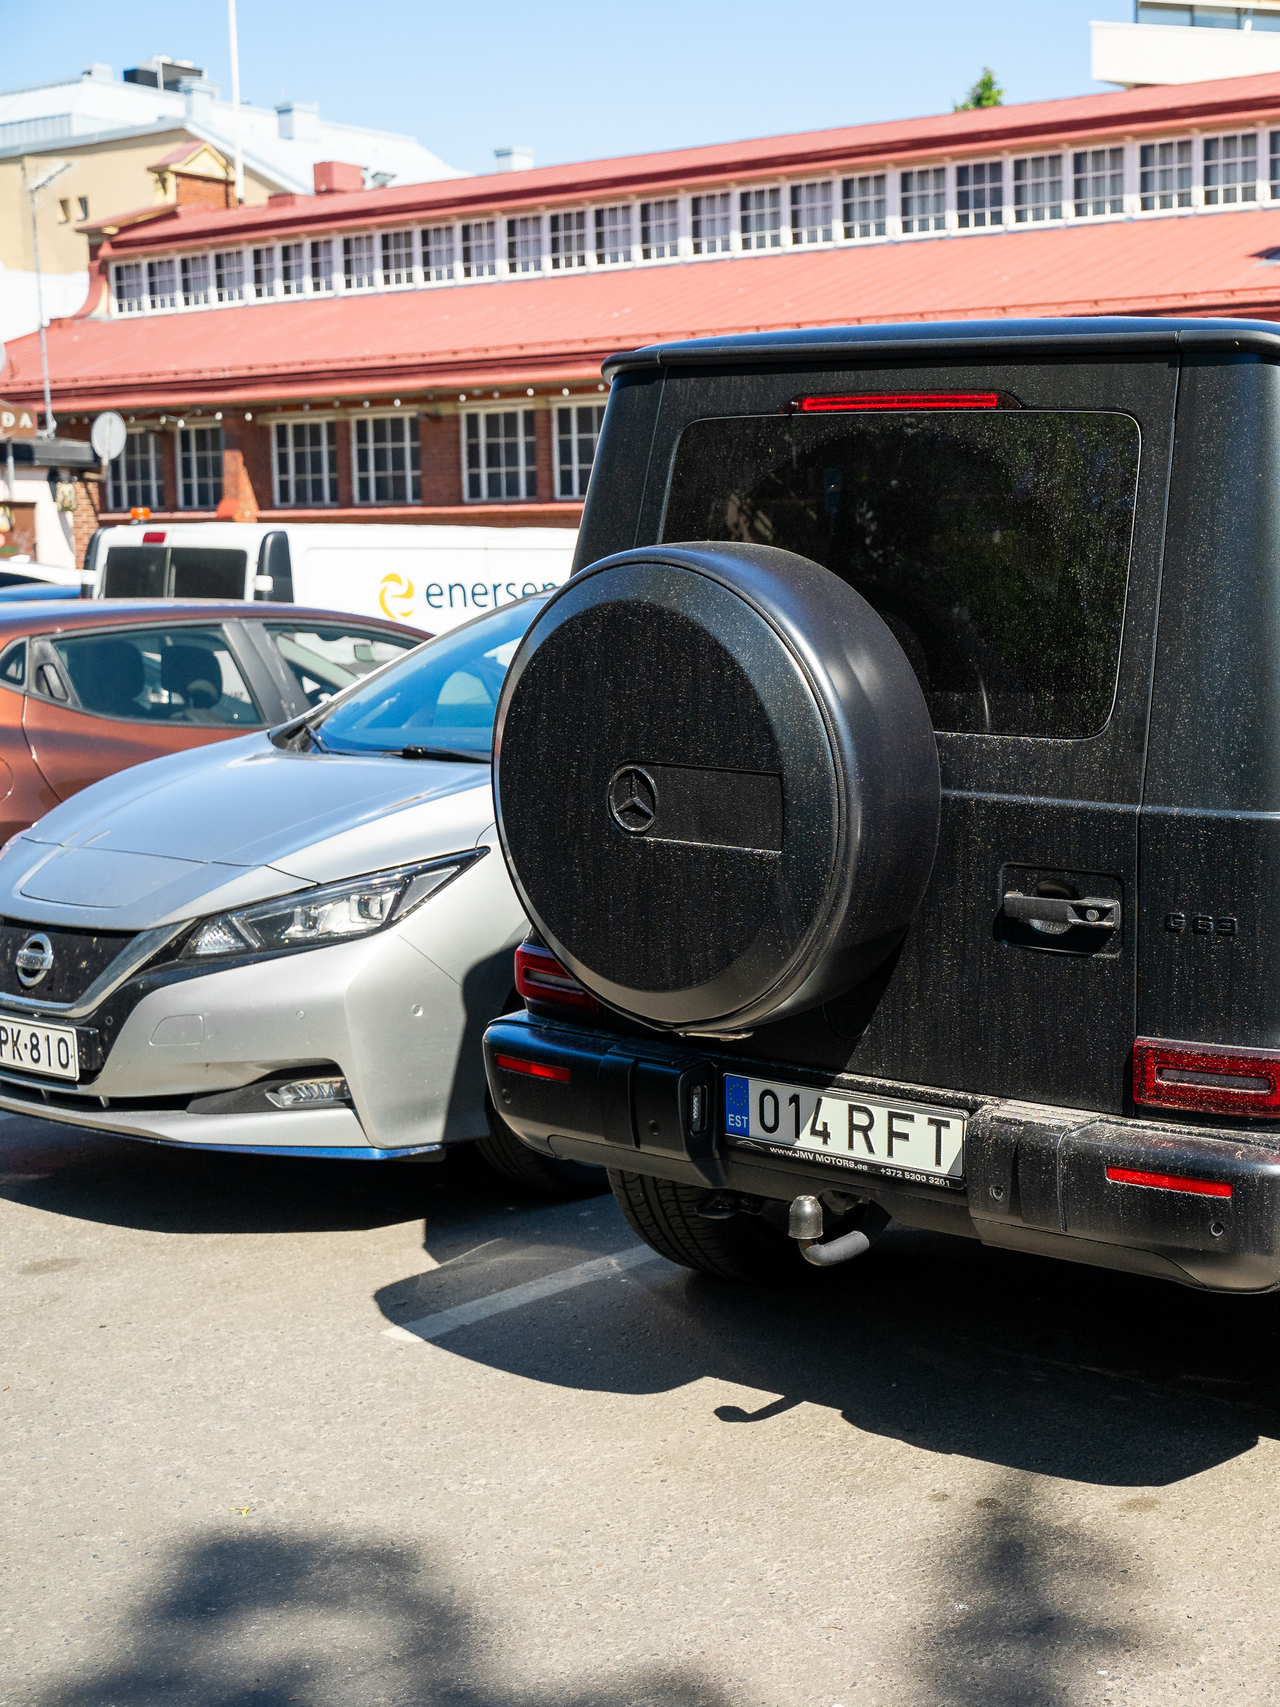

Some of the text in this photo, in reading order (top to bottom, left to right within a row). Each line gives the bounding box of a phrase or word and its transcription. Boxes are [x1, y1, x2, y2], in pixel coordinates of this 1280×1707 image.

[1165, 912, 1239, 937] G 63
[728, 1114, 749, 1129] EST
[758, 1088, 831, 1146] 014
[847, 1103, 951, 1168] RFT
[880, 1167, 903, 1179] +372
